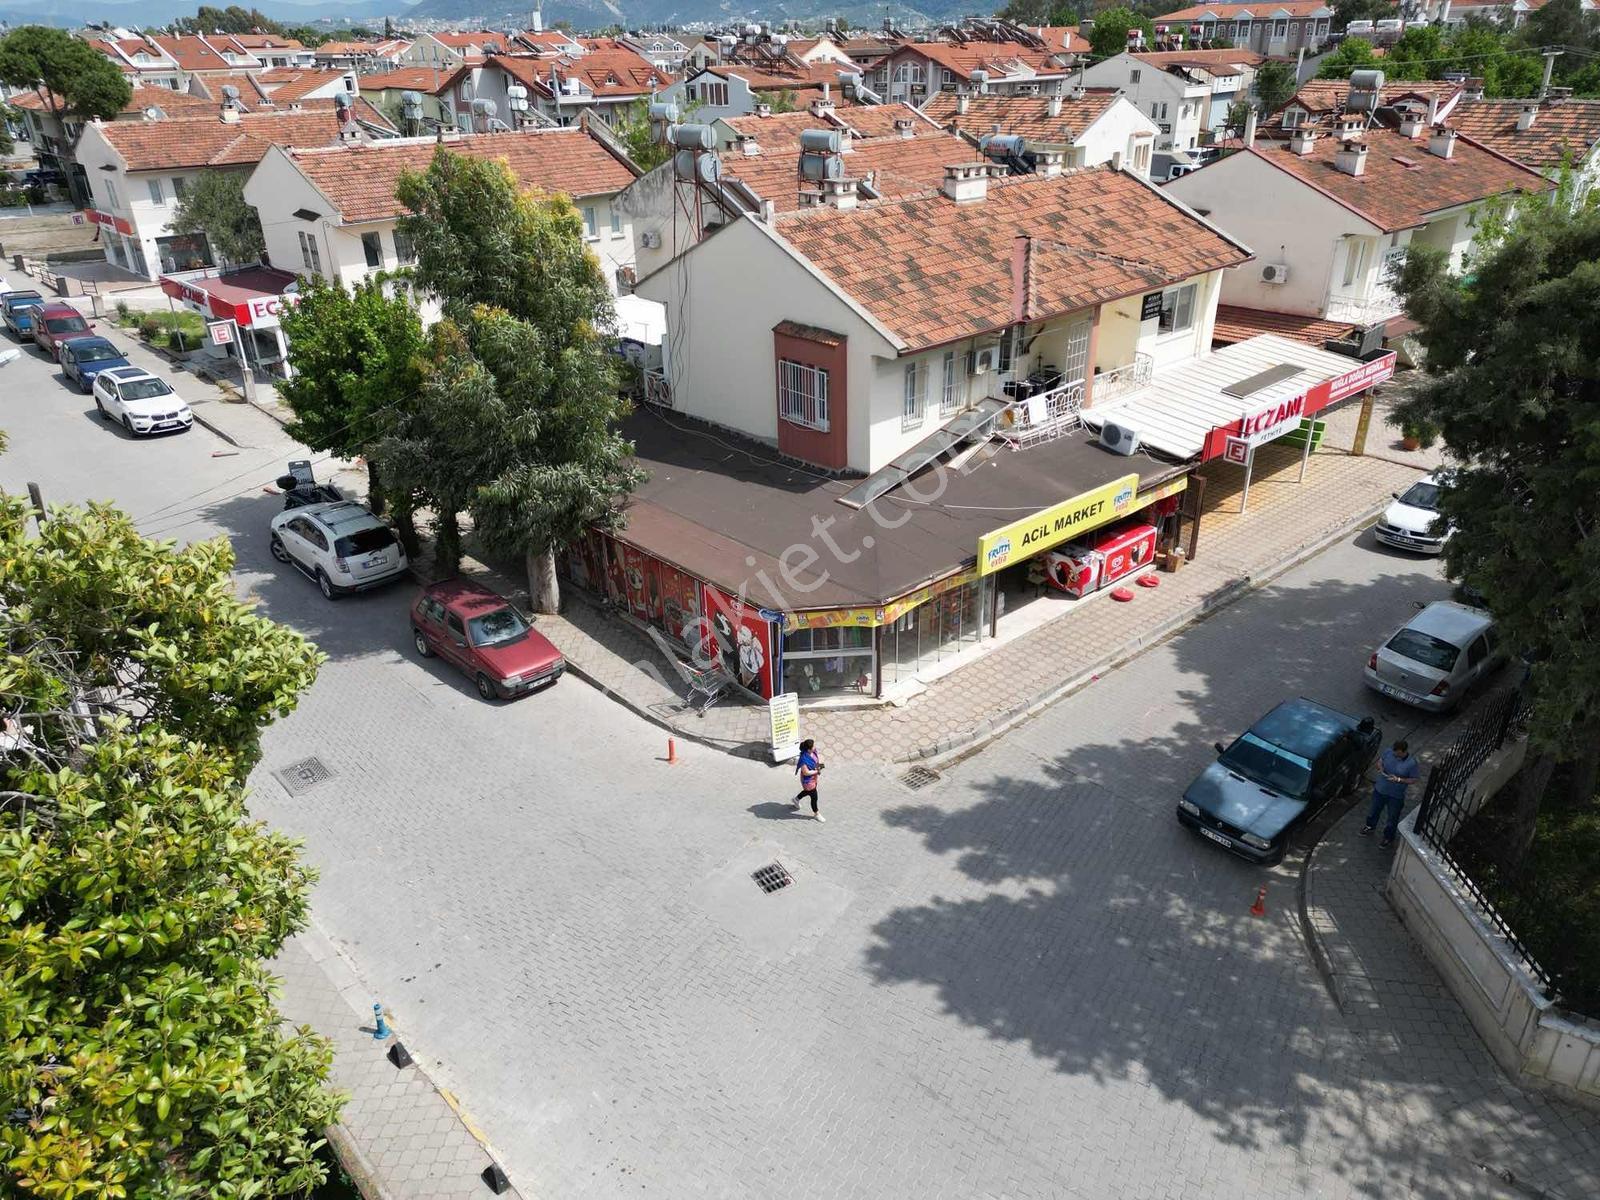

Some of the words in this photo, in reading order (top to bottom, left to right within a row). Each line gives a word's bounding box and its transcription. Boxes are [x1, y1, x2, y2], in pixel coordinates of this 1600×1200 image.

[1230, 444, 1243, 458] E
[1054, 500, 1105, 532] MARKET
[990, 555, 1007, 568] extra
